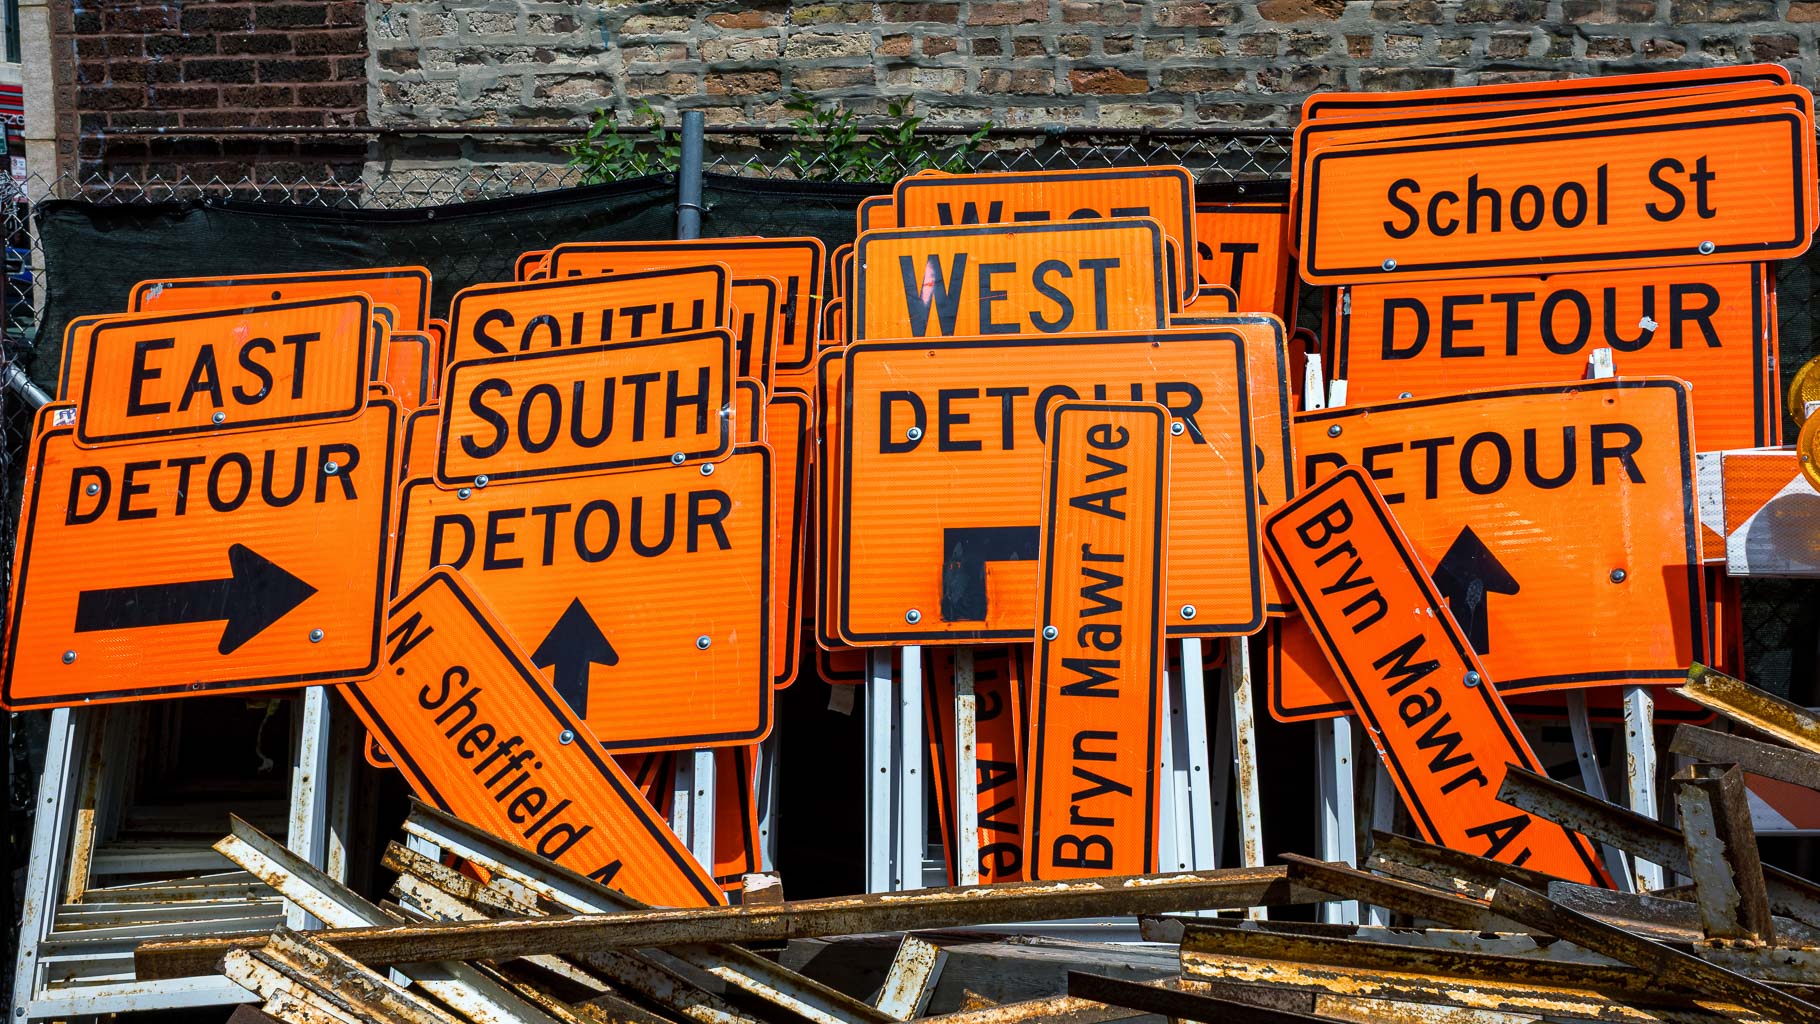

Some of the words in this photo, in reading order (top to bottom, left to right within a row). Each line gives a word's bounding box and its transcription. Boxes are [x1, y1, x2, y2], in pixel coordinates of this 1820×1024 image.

[1383, 163, 1608, 239] School
[1645, 155, 1718, 222] St
[899, 253, 1121, 337] WEST
[1381, 283, 1722, 360] DETOUR
[126, 332, 321, 417] EAST
[460, 366, 711, 459] SOUTH
[879, 381, 1207, 454] DETOR
[65, 443, 361, 526] DETOUR
[1069, 423, 1130, 520] Ave
[430, 489, 732, 571] DETOUR
[1060, 543, 1125, 698] Mawr
[1295, 498, 1388, 635] Bryn
[1373, 634, 1488, 795] Mawr
[386, 611, 434, 676] N.
[418, 665, 593, 861] Sheffield
[976, 759, 1023, 877] Ave
[1052, 729, 1133, 870] Bryn
